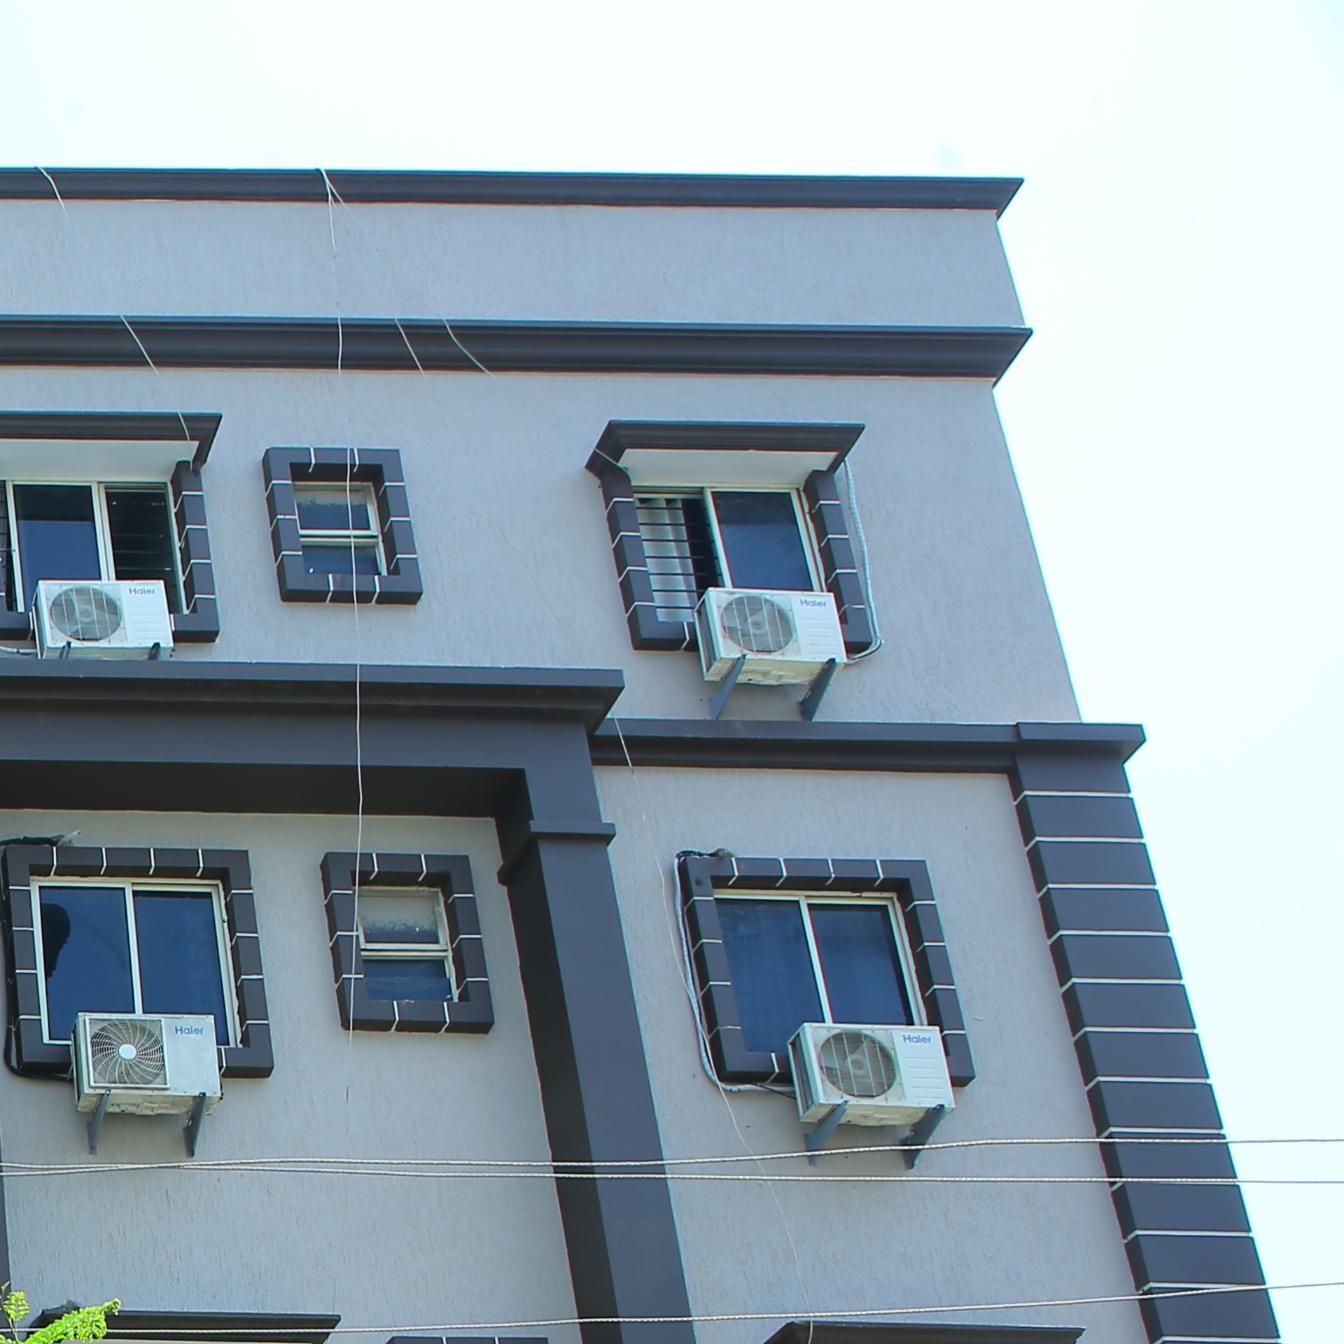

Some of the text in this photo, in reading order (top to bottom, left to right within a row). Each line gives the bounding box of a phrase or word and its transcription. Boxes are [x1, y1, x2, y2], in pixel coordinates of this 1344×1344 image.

[128, 586, 156, 596] Haier
[800, 598, 827, 608] Haier
[175, 1025, 204, 1036] Haier
[902, 1033, 932, 1044] Haier
